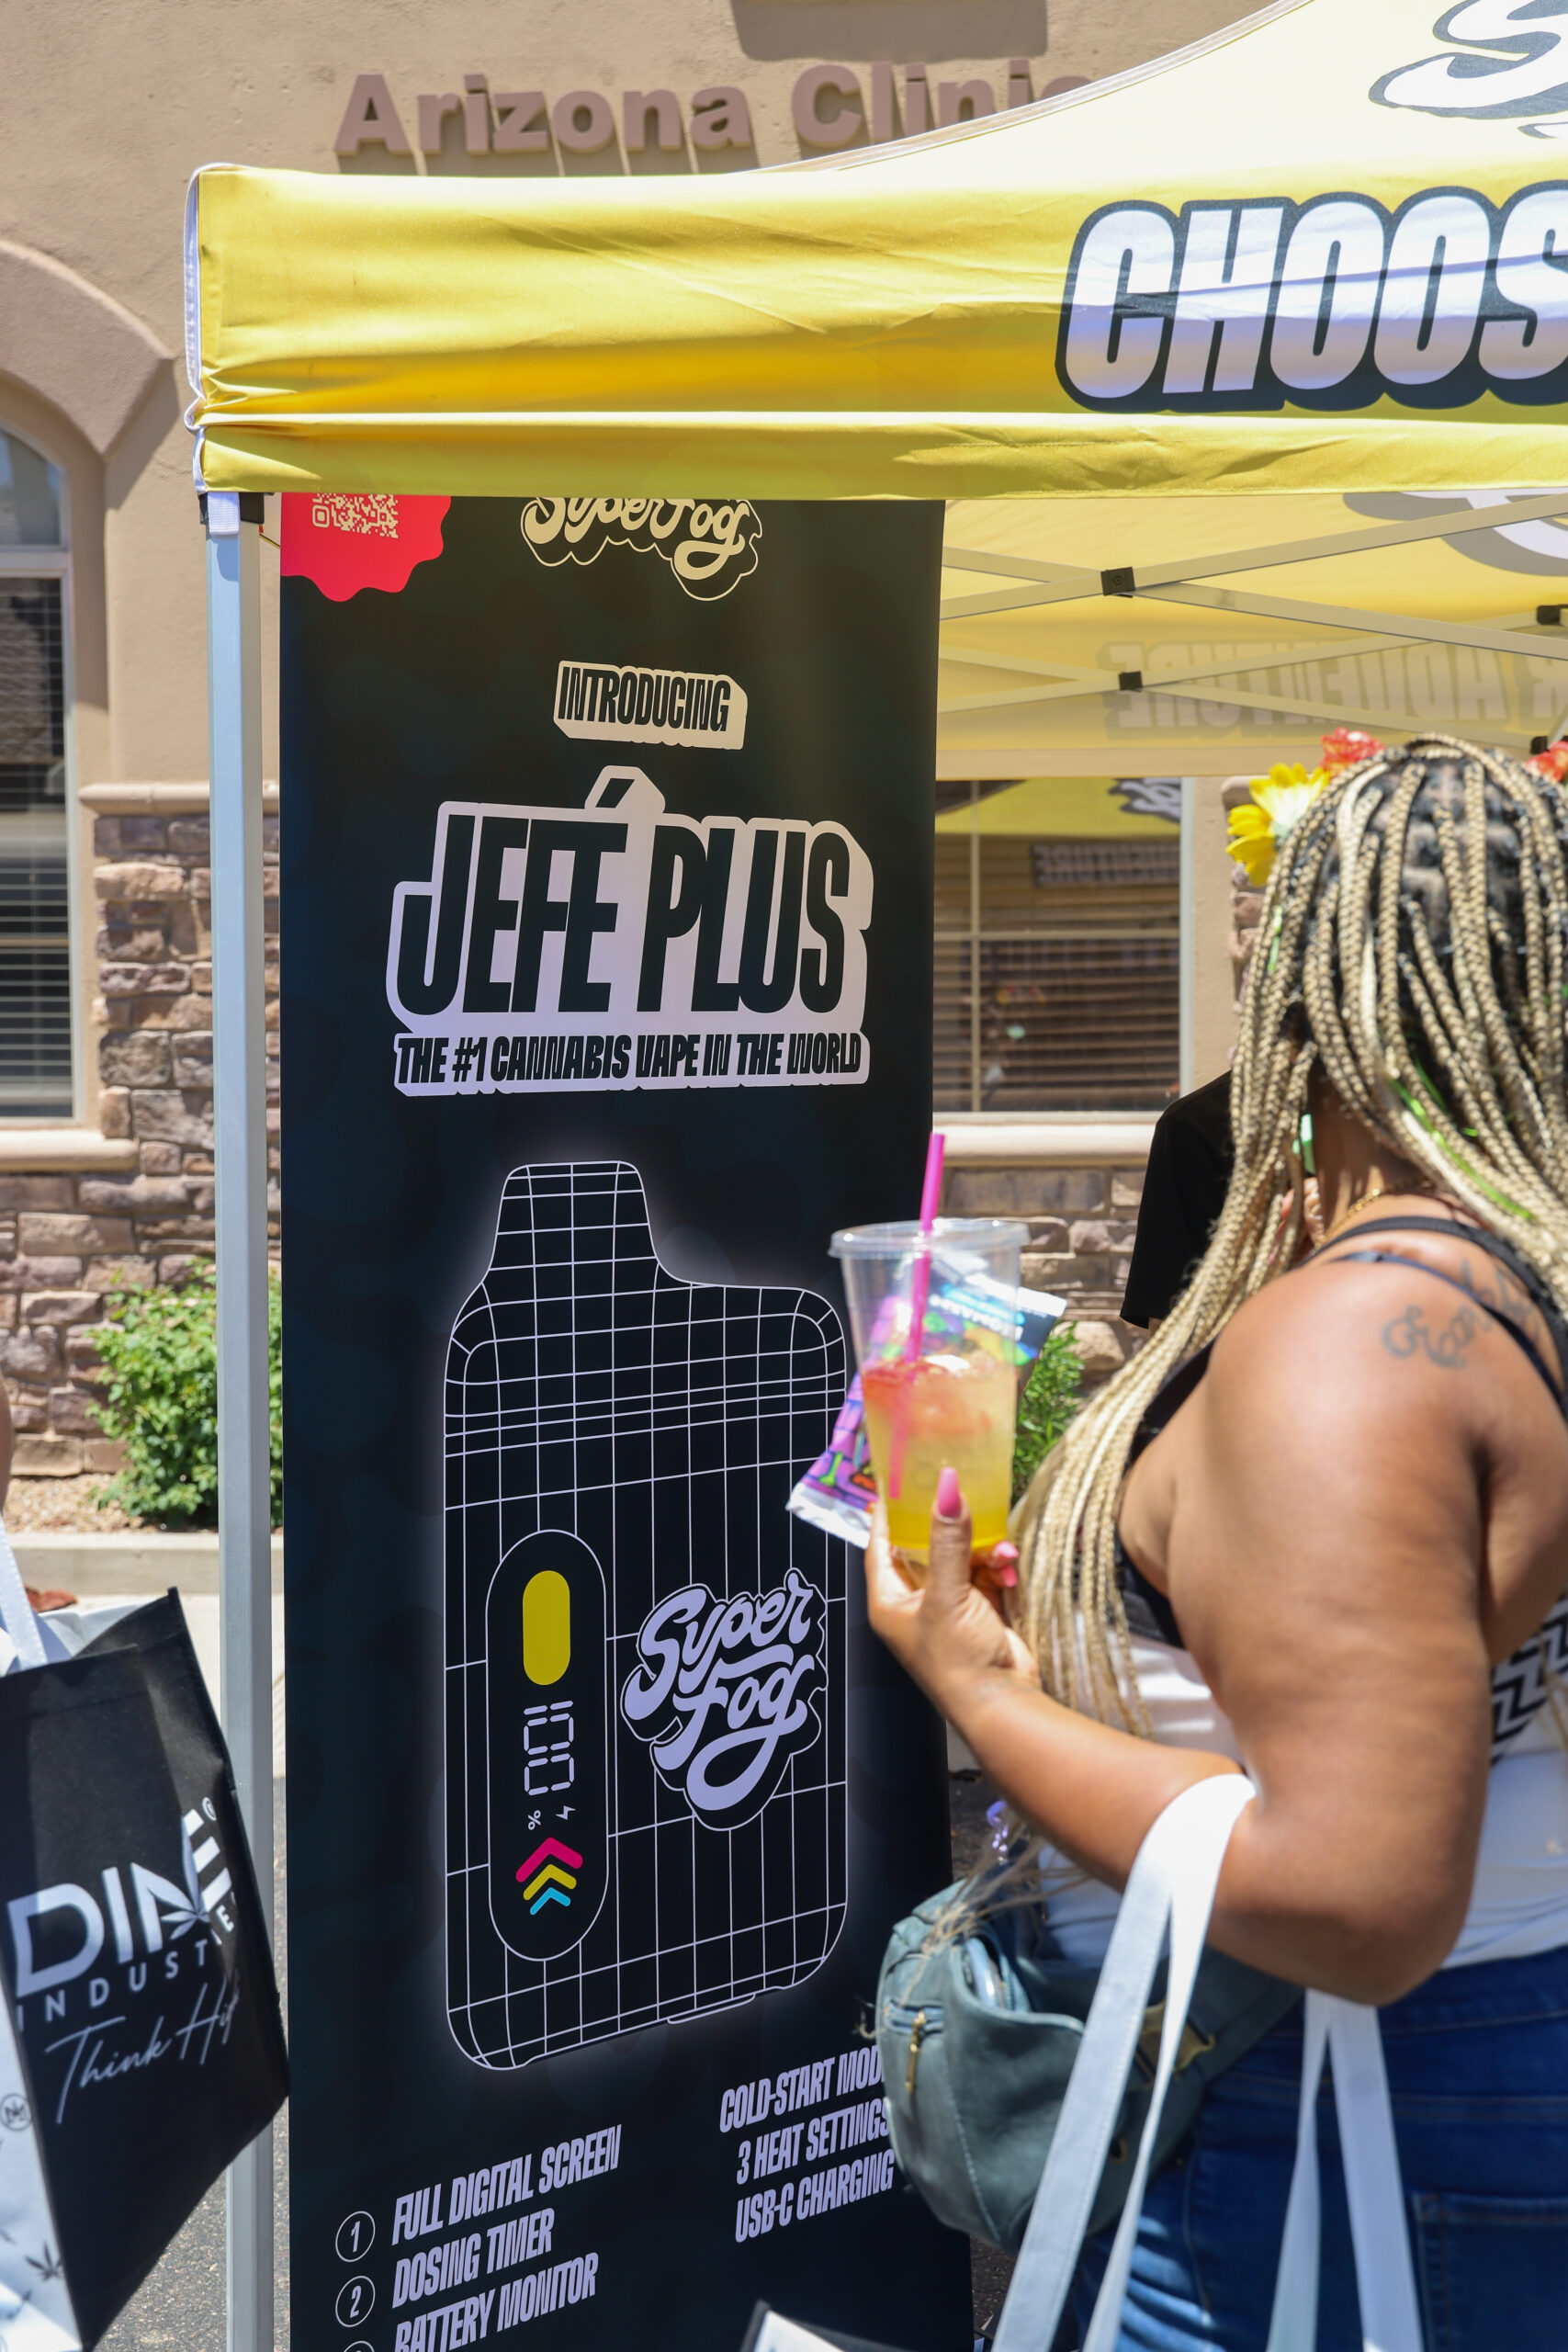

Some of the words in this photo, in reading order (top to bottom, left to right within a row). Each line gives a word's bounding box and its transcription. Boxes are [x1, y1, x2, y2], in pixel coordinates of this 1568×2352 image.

[333, 72, 751, 156] Arizona
[790, 59, 1095, 149] Clini
[1059, 184, 1568, 406] CHOOS
[556, 664, 732, 733] INTRODUCING
[636, 823, 851, 1014] PLUS
[397, 1037, 449, 1084] THE
[452, 1036, 487, 1083] #1
[490, 1035, 633, 1082] CANNABIS
[635, 1034, 700, 1078] VAPE
[701, 1034, 732, 1077] IN
[737, 1033, 783, 1076] THE
[785, 1032, 862, 1075] WORLD
[625, 1572, 813, 1720] Super
[653, 1644, 815, 1811] Fog
[44, 2015, 173, 2125] Think
[719, 2056, 836, 2133] COLD-START
[836, 2044, 885, 2097] MOD
[391, 2182, 444, 2245] FULL
[448, 2153, 534, 2226] DIGITAL
[538, 2124, 623, 2194] SCREEN
[736, 2140, 751, 2185] 3
[753, 2122, 806, 2180] HEAT
[806, 2098, 890, 2162] SETTINGS
[735, 2182, 795, 2244] USB-C
[795, 2148, 896, 2221] CHARGING
[391, 2232, 482, 2309] DOSING
[486, 2207, 556, 2275] TIMER
[395, 2288, 496, 2352] BATTERY
[496, 2251, 599, 2334] MONITOR
